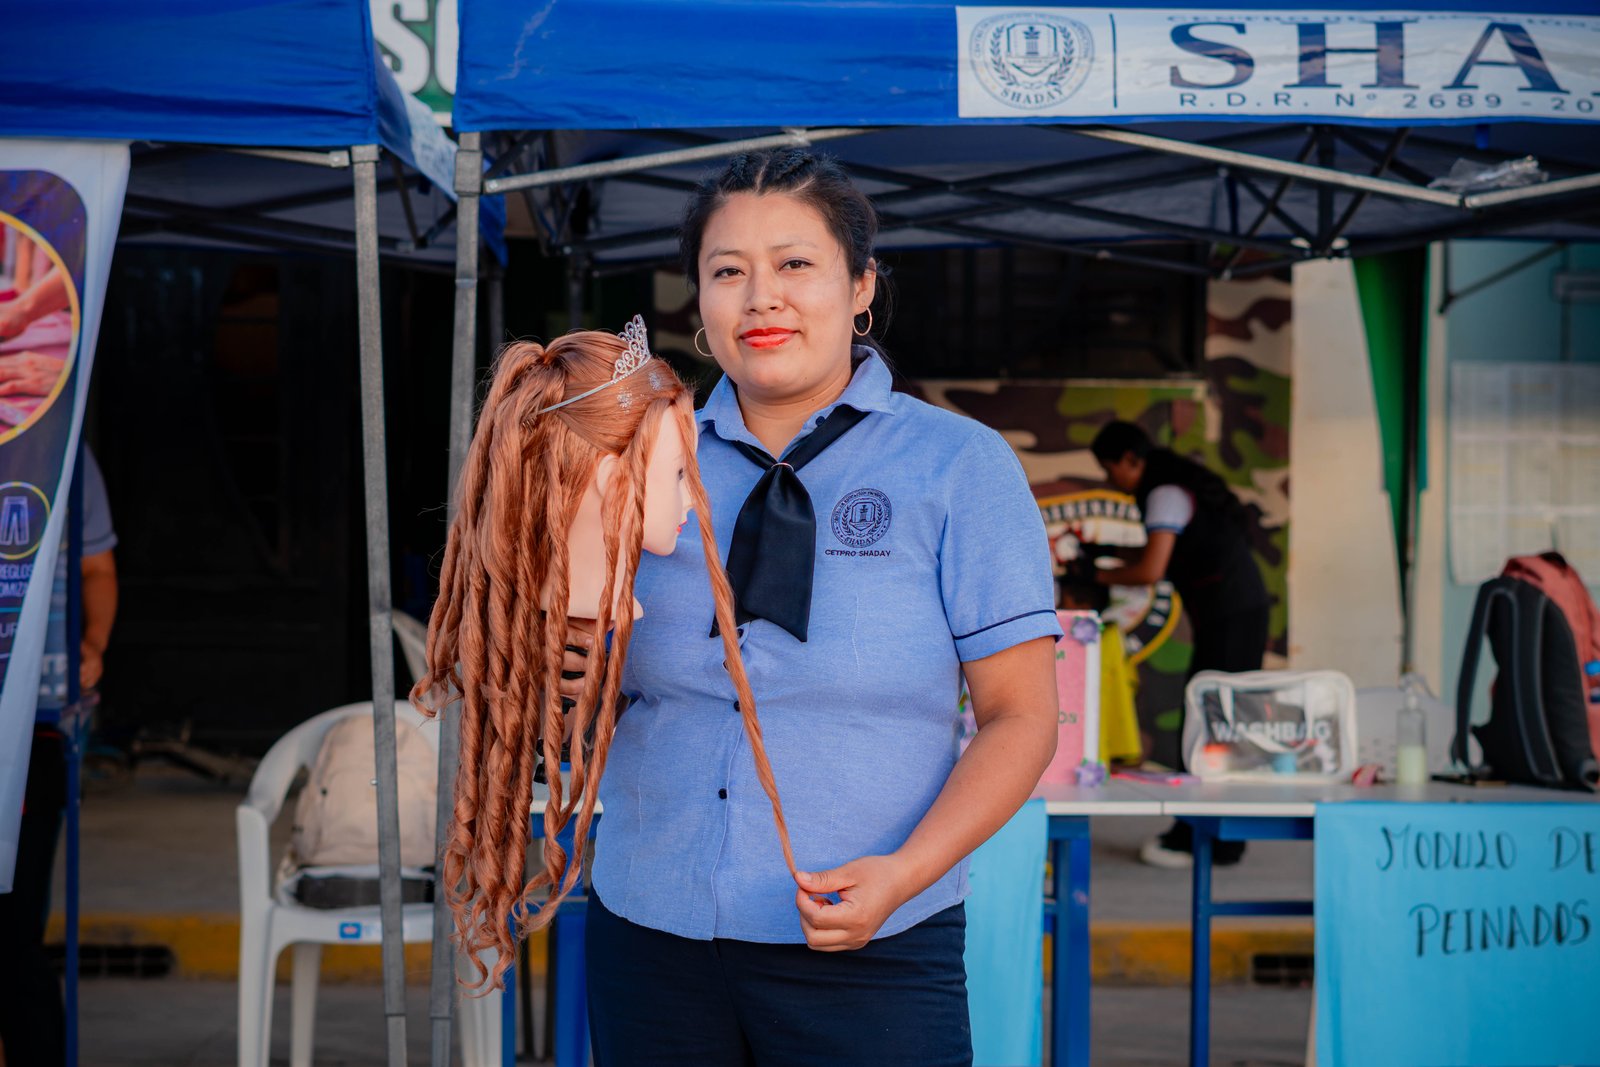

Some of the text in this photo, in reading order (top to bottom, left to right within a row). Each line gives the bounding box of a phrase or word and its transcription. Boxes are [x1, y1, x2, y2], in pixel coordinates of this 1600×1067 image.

[1169, 21, 1600, 97] SHA
[1000, 85, 1065, 106] SHADAY
[844, 535, 877, 546] SHADAY
[824, 549, 857, 557] CETPRO
[1407, 898, 1591, 959] PEINADOS
